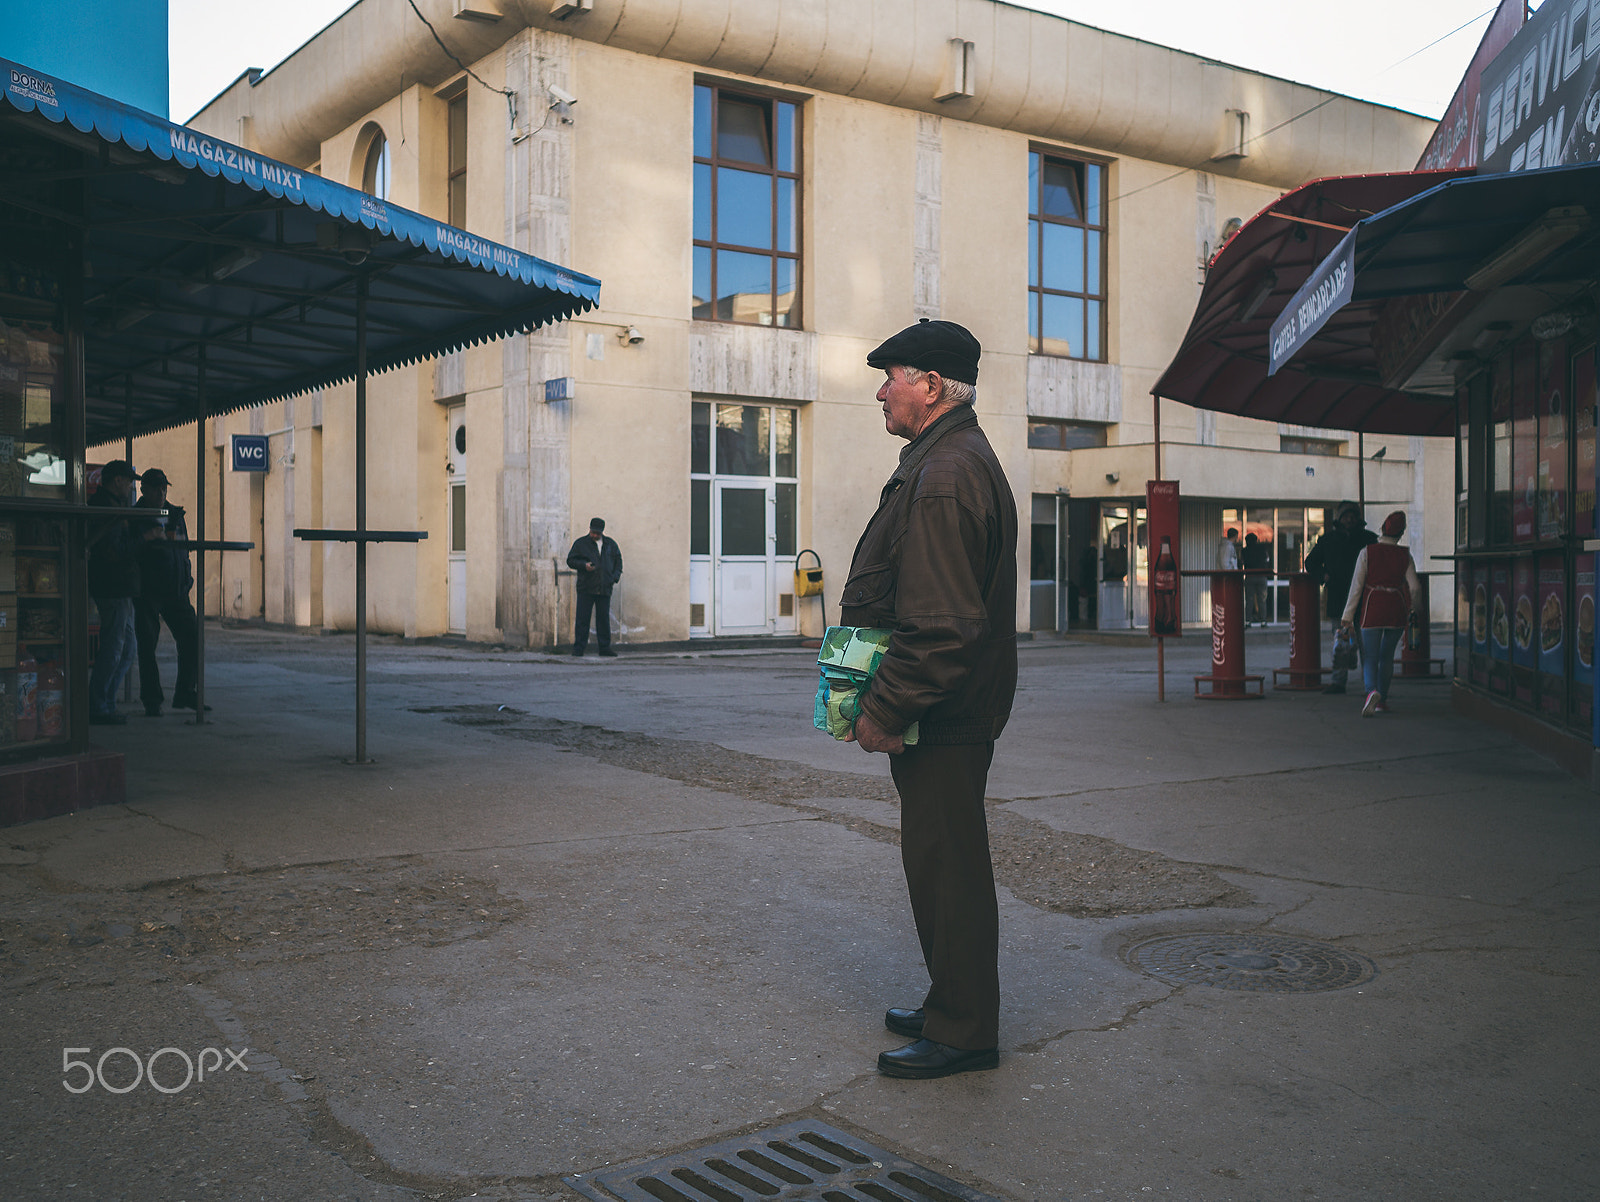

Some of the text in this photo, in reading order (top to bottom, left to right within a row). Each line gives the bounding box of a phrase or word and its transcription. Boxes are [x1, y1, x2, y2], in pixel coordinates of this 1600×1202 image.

[11, 70, 56, 96] DORNA
[170, 128, 302, 191] MAGAZIN MIXT
[436, 226, 520, 269] MAGAZIN MIXT
[1273, 260, 1347, 361] CARTELE REINCARCARE
[238, 446, 263, 459] WC
[1212, 603, 1226, 665] Coca-Cola
